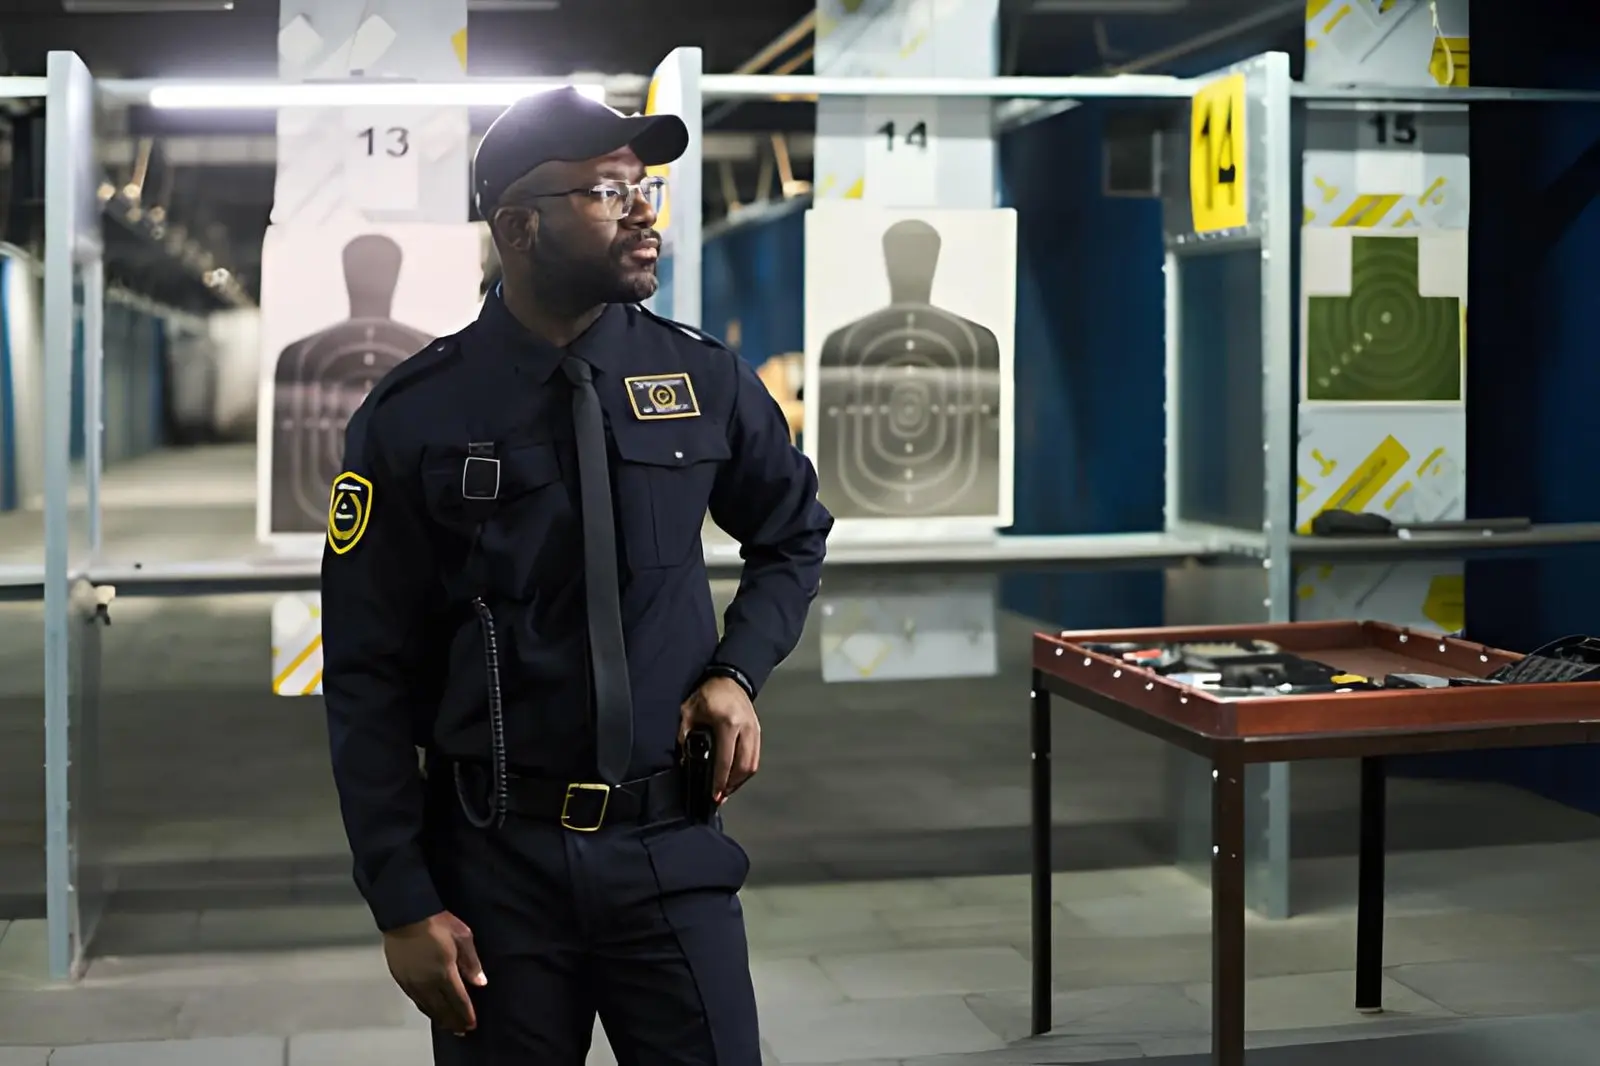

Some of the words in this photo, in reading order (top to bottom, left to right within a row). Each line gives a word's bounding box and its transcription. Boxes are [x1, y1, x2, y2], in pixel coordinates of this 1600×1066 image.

[357, 126, 410, 158] 13
[876, 120, 928, 152] 14
[1366, 111, 1418, 145] 15
[1200, 95, 1236, 210] 14
